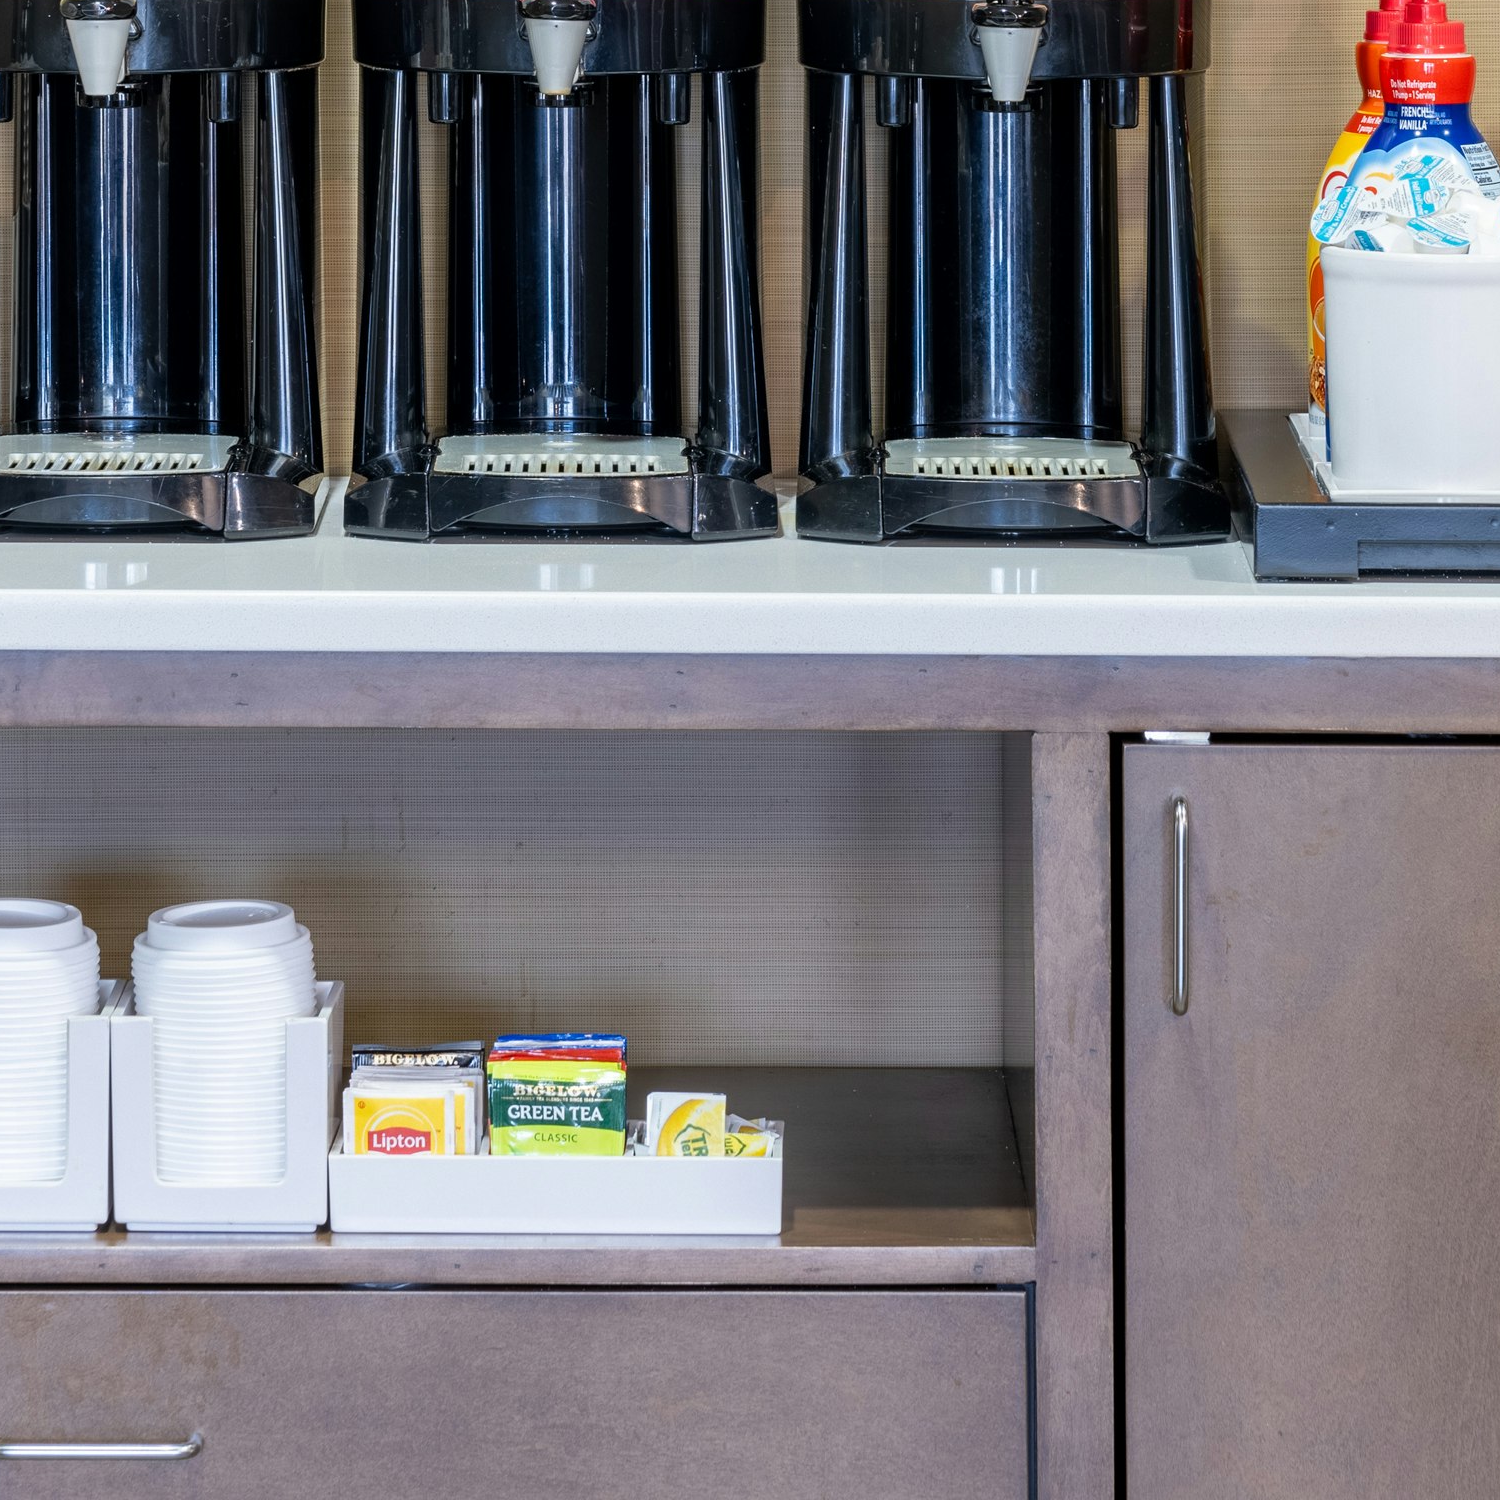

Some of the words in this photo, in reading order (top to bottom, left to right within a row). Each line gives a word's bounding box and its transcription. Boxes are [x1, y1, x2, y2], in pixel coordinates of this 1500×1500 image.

[1390, 79, 1397, 88] Do
[1397, 80, 1407, 88] Not
[1407, 80, 1437, 90] Refrigerate
[1395, 91, 1408, 100] Pump
[1416, 91, 1436, 101] Serving
[1401, 106, 1426, 118] FRENCH
[1399, 119, 1427, 130] VANILLA
[507, 1105, 565, 1120] GREEN
[568, 1106, 604, 1121] TEA
[373, 1133, 425, 1151] Lipton
[534, 1133, 578, 1143] CLASSIC
[691, 1132, 709, 1156] TR
